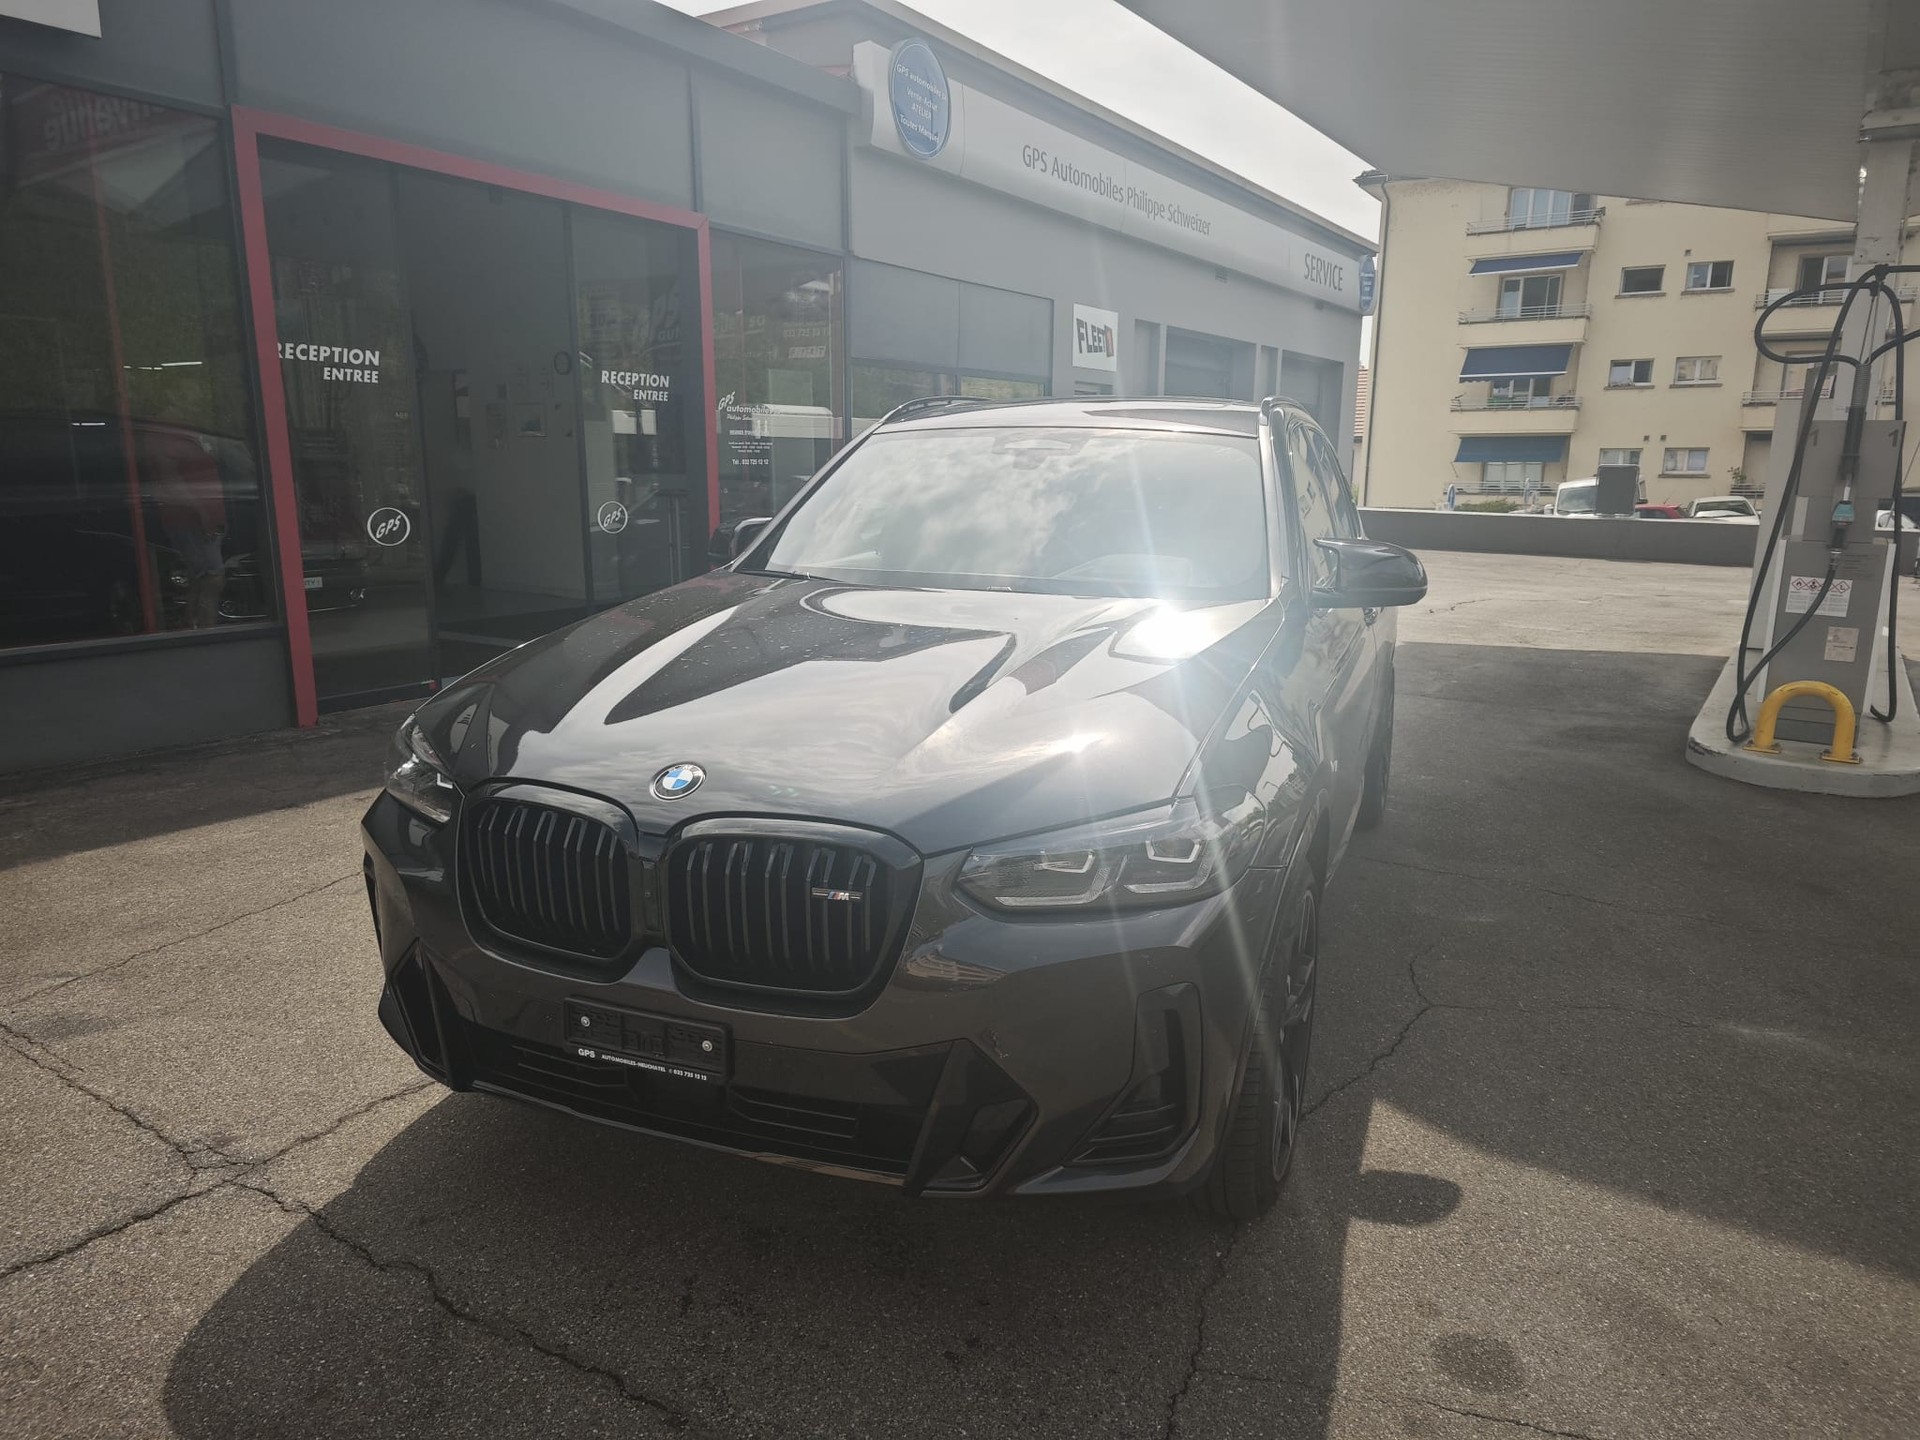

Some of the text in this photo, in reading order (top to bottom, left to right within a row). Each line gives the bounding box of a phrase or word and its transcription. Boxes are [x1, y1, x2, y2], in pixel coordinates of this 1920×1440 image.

[1022, 144, 1212, 236] GPS Automobiles Philippe Schweizer
[1303, 252, 1344, 292] SERVICE
[323, 366, 379, 384] ENTREE
[600, 369, 671, 388] RECEPTION
[632, 389, 669, 402] ENTREE
[718, 391, 736, 411] GPS
[1888, 428, 1900, 448] 1
[375, 515, 402, 539] GPS
[603, 507, 622, 528] GPS
[578, 1048, 596, 1059] GPS
